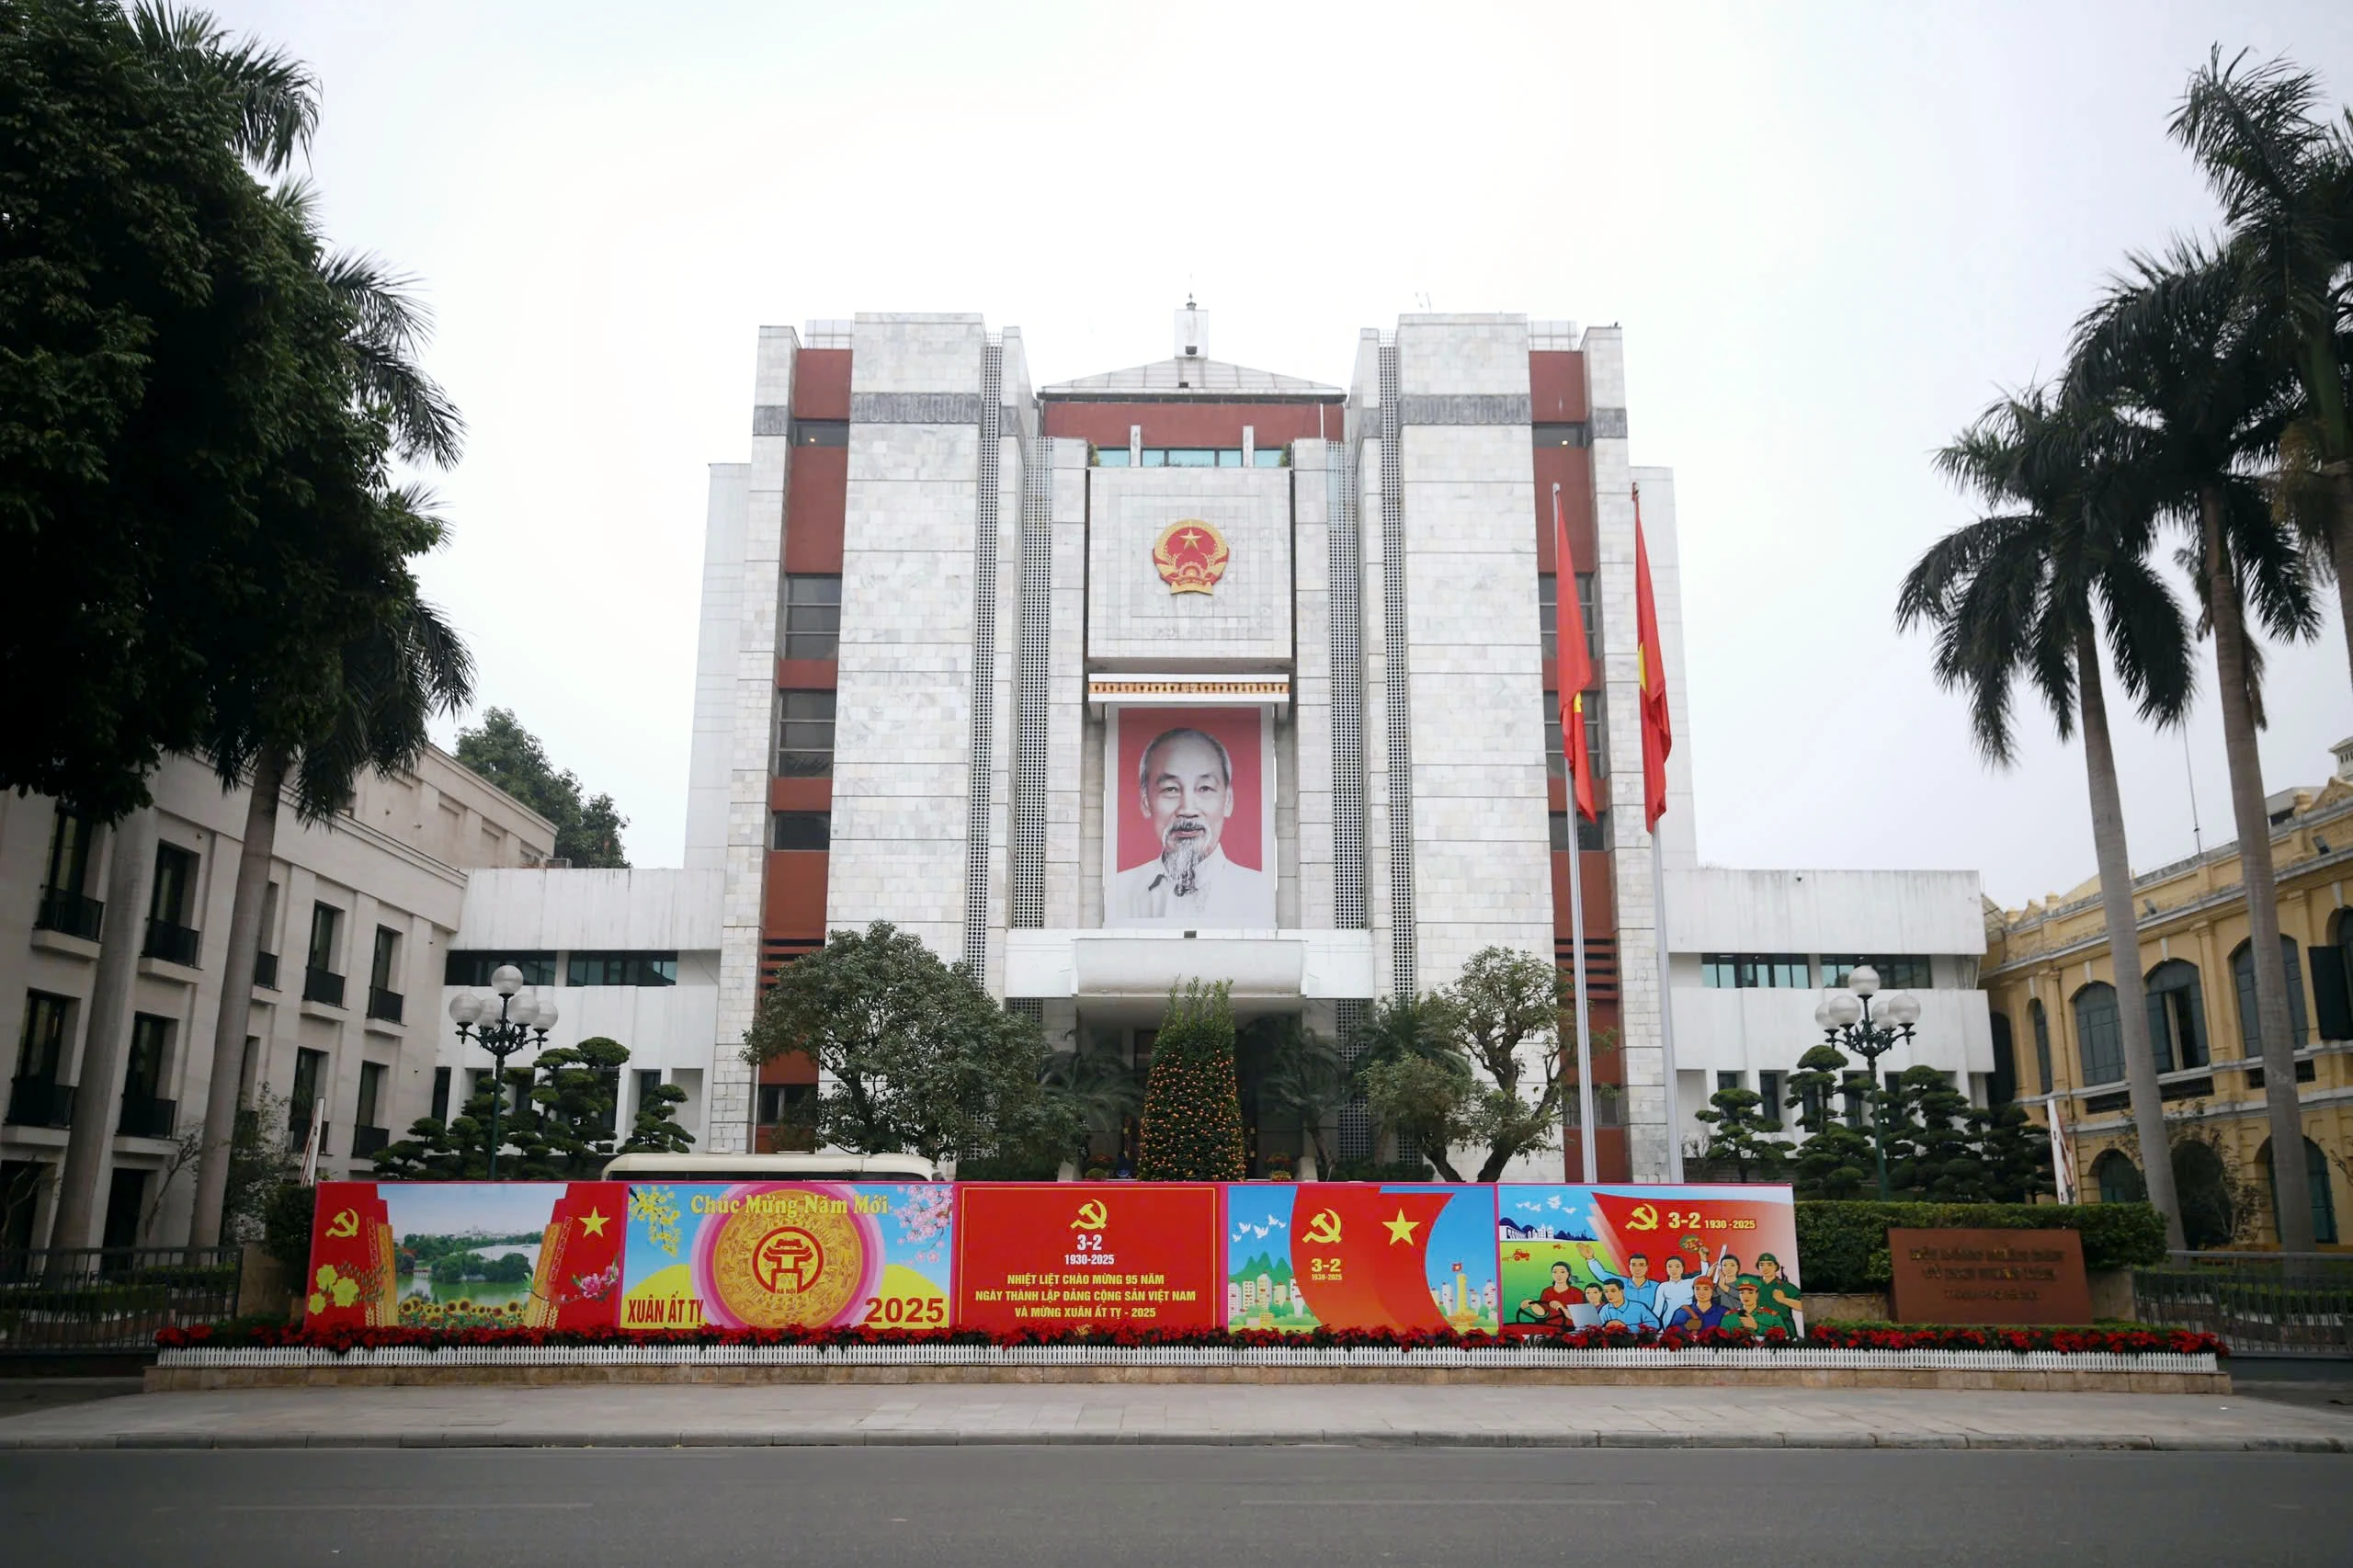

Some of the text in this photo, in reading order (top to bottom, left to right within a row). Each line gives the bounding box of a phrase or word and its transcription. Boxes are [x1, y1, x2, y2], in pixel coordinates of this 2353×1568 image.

[691, 1194, 889, 1218] Chúc Mừng Năm Mới
[1668, 1212, 1701, 1229] 3-2
[1076, 1233, 1102, 1250] 3-2
[1064, 1254, 1115, 1265] 1930-2025
[1311, 1258, 1341, 1272] 3-2
[1007, 1272, 1165, 1286] NHIỆT LIỆT CHÀO MỪNG 95 NĂM
[975, 1288, 1196, 1302] NGÀY THÀNH LẬP ĐẢNG CỘNG SẢN VIỆT NAM
[627, 1293, 665, 1323] XUÂN
[667, 1290, 685, 1323] ẤT
[864, 1297, 944, 1323] 2025
[1015, 1305, 1029, 1317] VÀ
[1030, 1305, 1061, 1317] MỪNG
[1064, 1305, 1092, 1317] XUÂN
[1095, 1303, 1108, 1317] ẤT
[1109, 1308, 1121, 1319] TỴ
[1131, 1307, 1156, 1317] 2025
